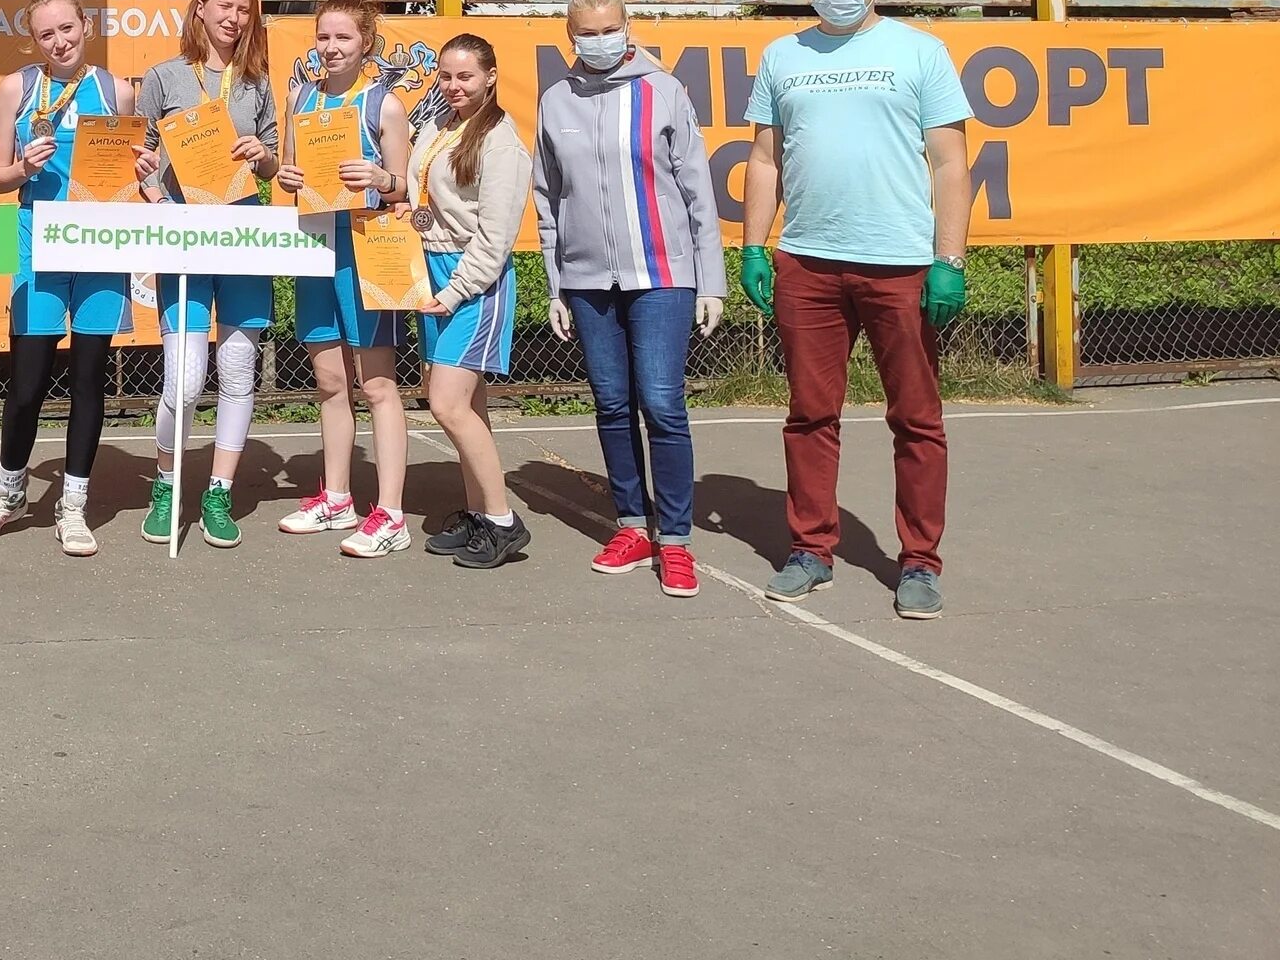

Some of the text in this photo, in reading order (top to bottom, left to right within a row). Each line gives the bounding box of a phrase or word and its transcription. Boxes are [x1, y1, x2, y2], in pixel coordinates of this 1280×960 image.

[782, 70, 896, 92] QUIKSILVER
[88, 138, 130, 146] ДИПЛОМ
[180, 127, 220, 149] ДИПЛОМ
[308, 133, 346, 146] ДИПЛОМ
[43, 223, 328, 251] #СпортНормаЖизни
[367, 235, 407, 244] ДИПЛОМ
